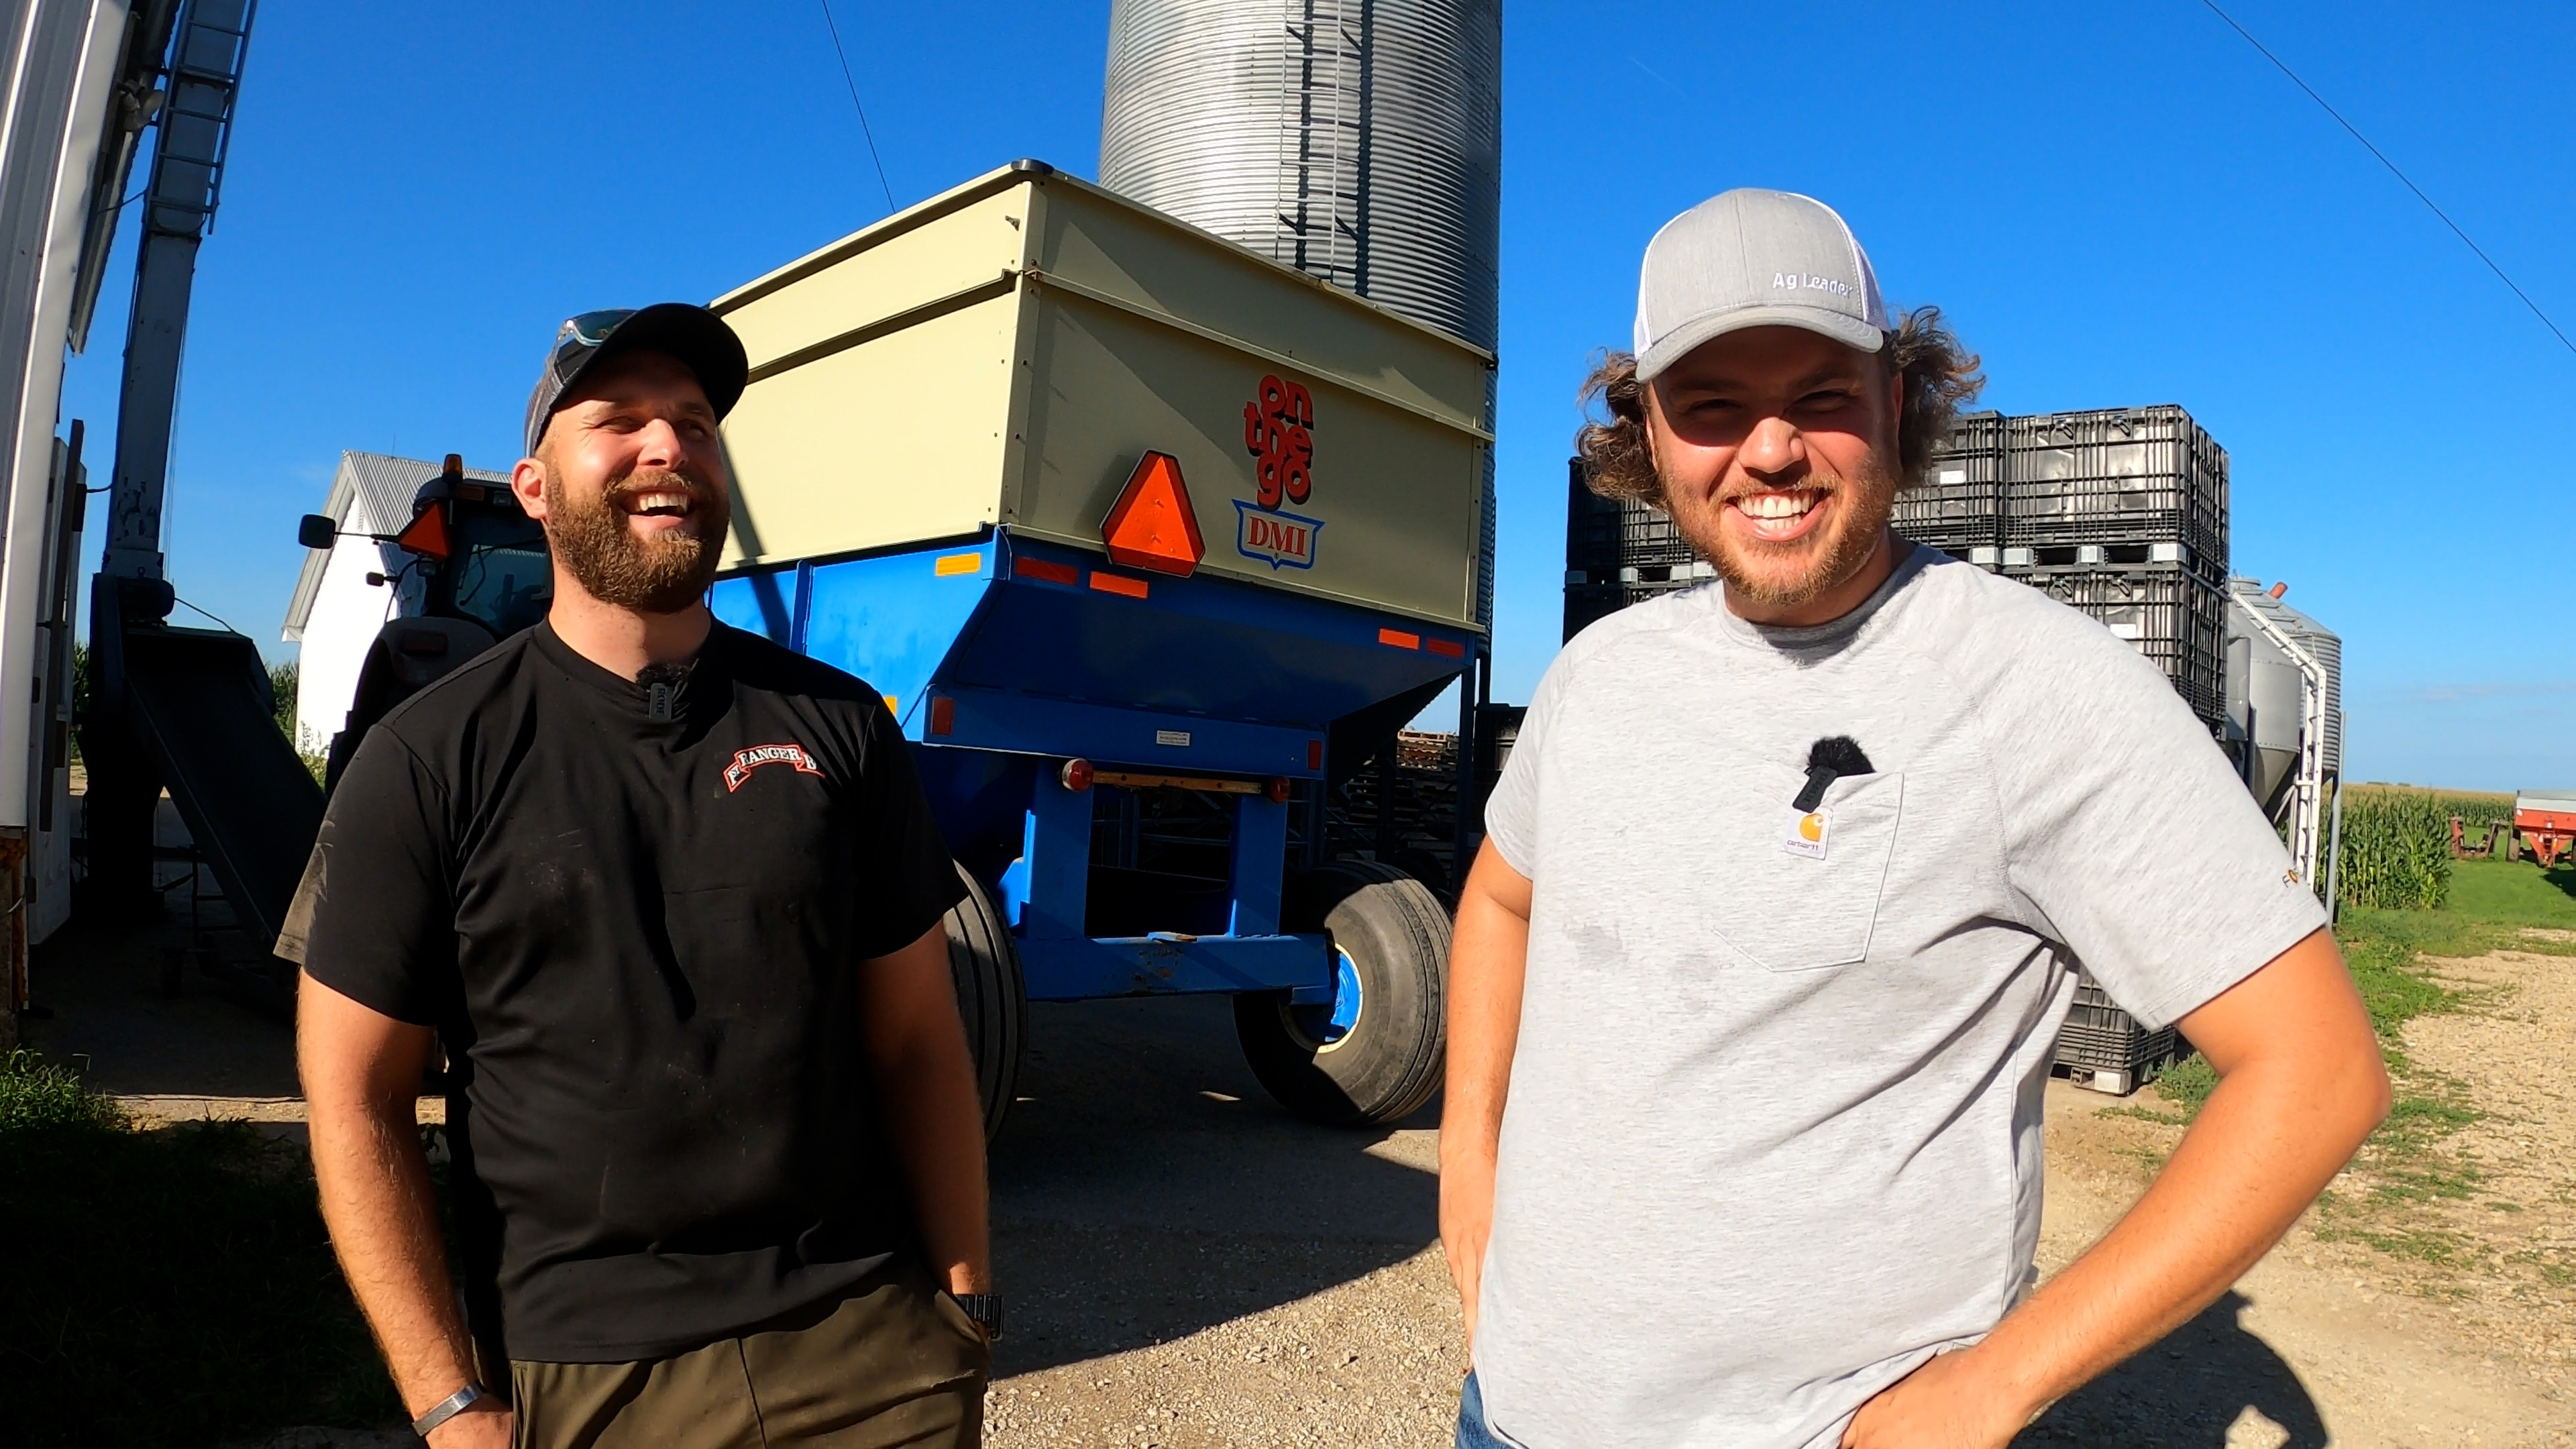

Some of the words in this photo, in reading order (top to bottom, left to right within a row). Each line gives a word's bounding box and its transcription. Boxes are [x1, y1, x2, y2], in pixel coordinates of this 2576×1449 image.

[1772, 272, 1797, 290] Ag
[1803, 272, 1853, 299] Leader
[1258, 374, 1313, 430] on
[1243, 401, 1313, 469] the
[1256, 454, 1311, 511] go
[1248, 516, 1307, 556] DMI
[737, 747, 803, 767] RANGER
